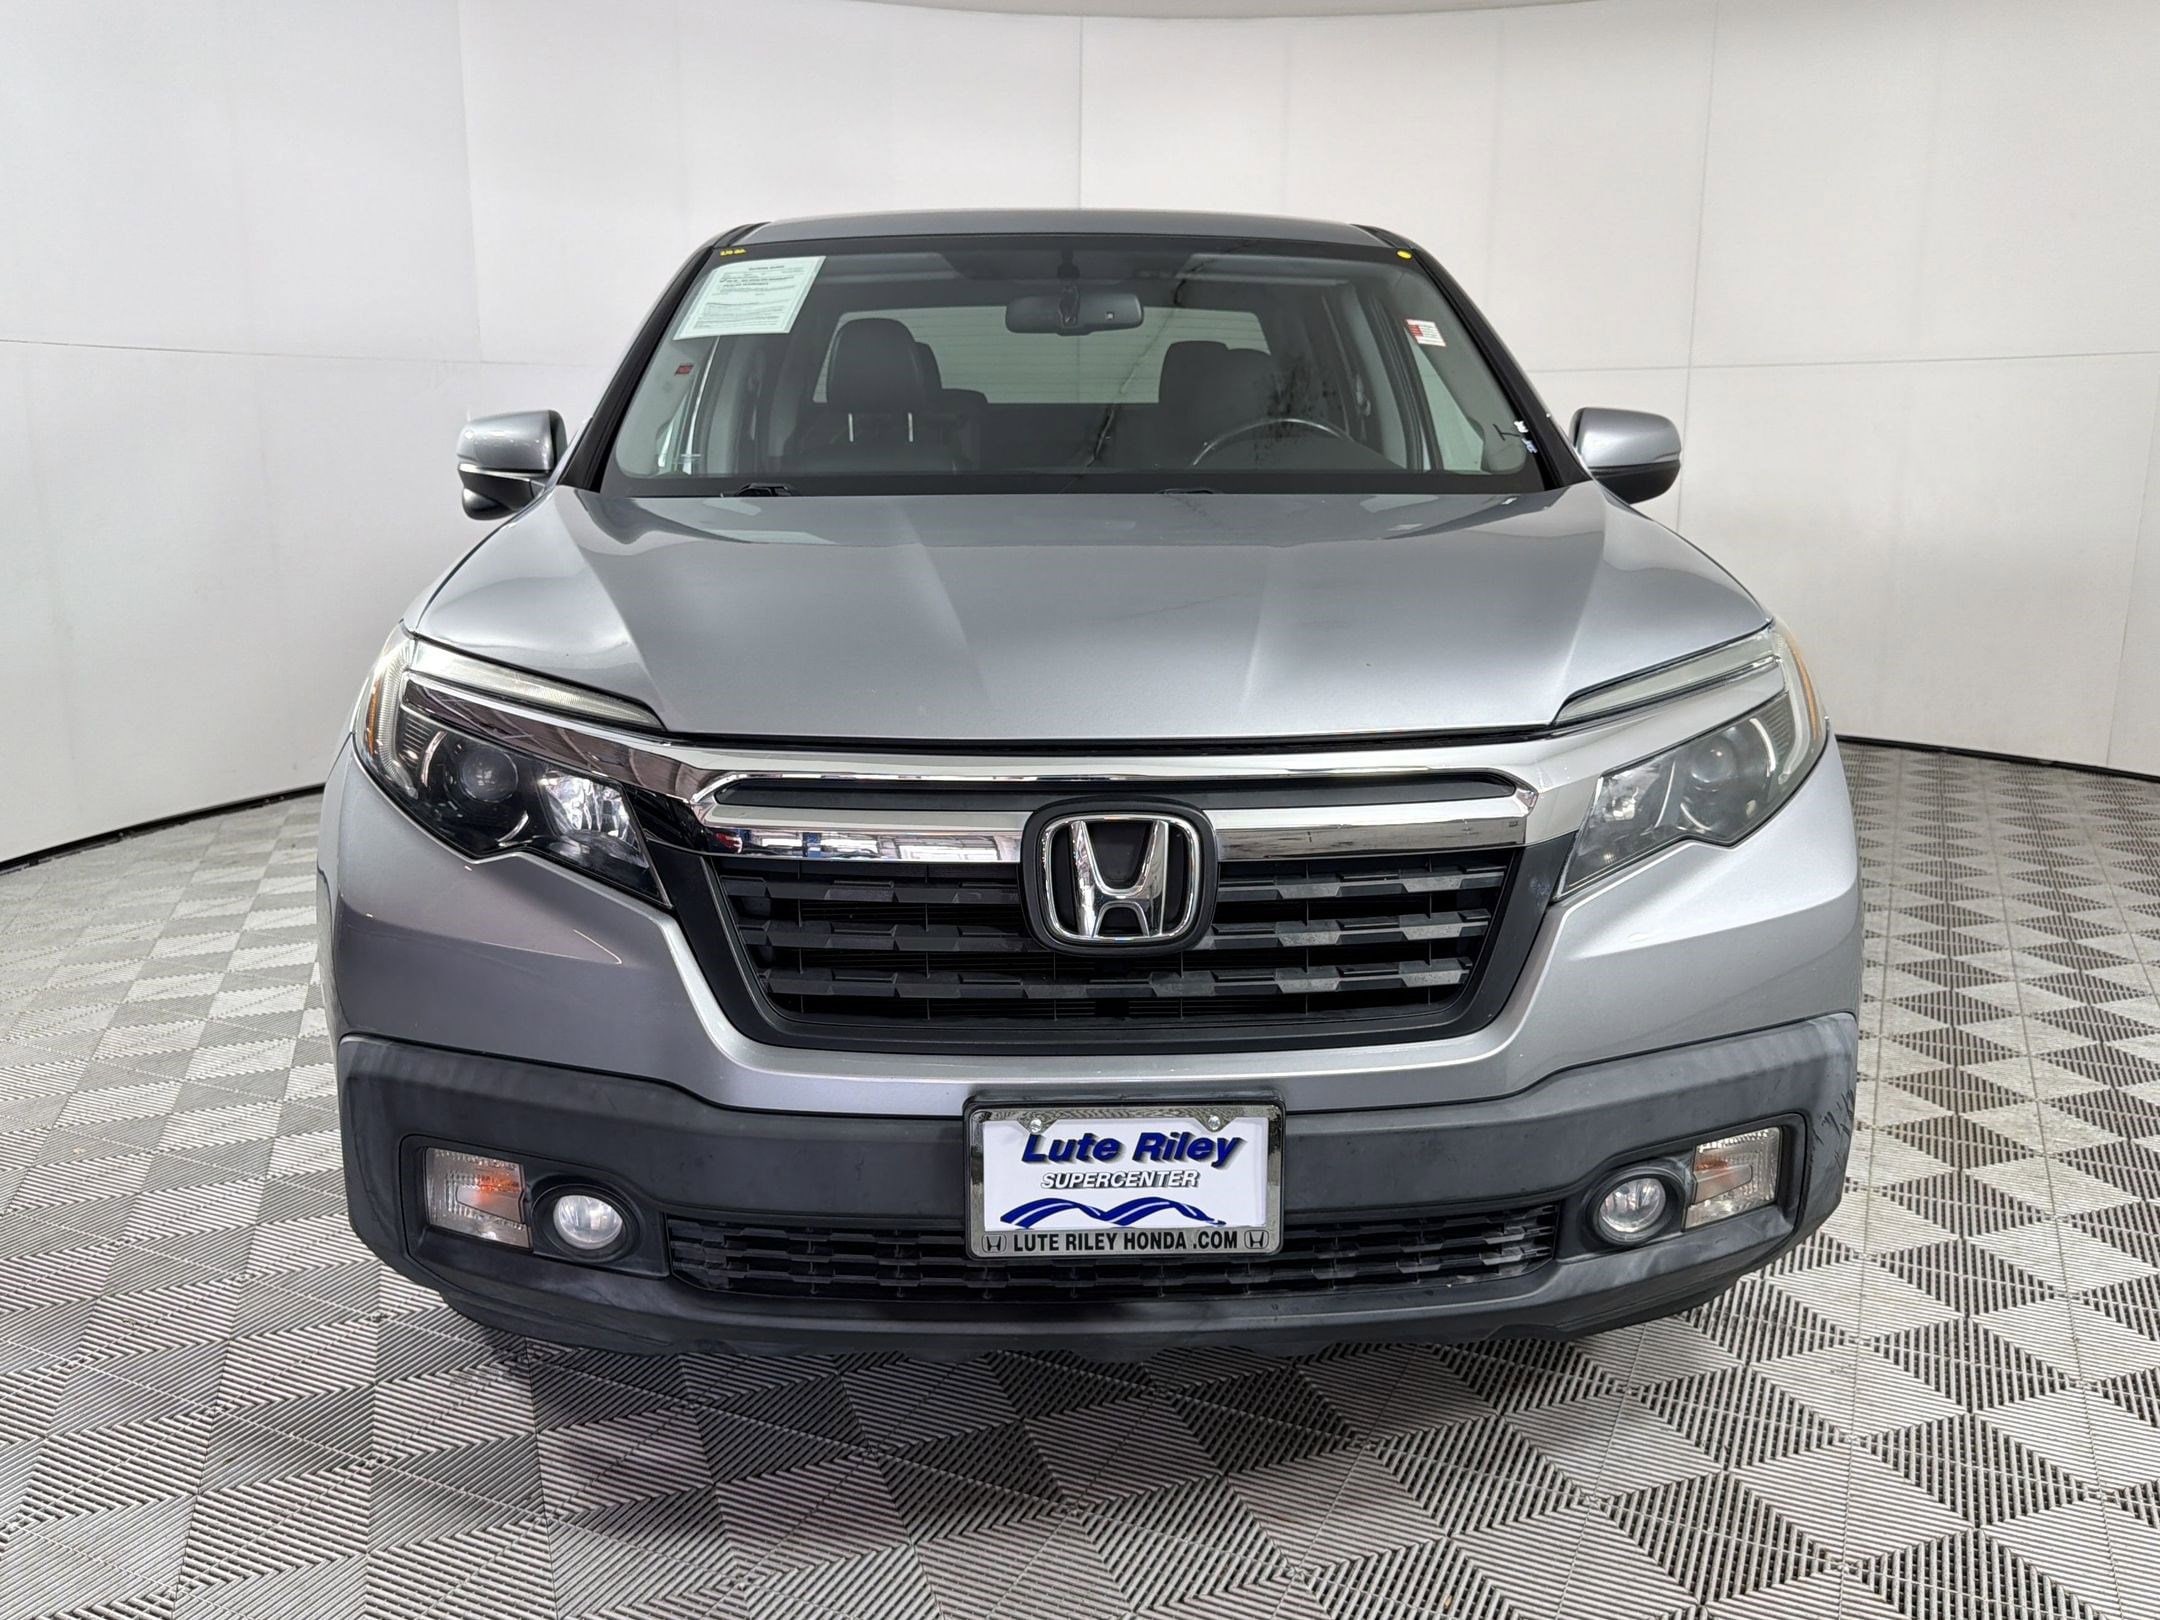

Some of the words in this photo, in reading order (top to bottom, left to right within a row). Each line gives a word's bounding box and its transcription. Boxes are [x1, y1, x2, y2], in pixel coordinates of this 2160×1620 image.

[1022, 1132, 1123, 1164] Lute
[1133, 1131, 1242, 1168] Riley
[1041, 1169, 1200, 1189] SUPERCENTER
[1013, 1234, 1059, 1252] LUTE
[1066, 1233, 1117, 1251] RILEY
[1123, 1232, 1187, 1250] HONDA
[1192, 1231, 1238, 1249] .COM
